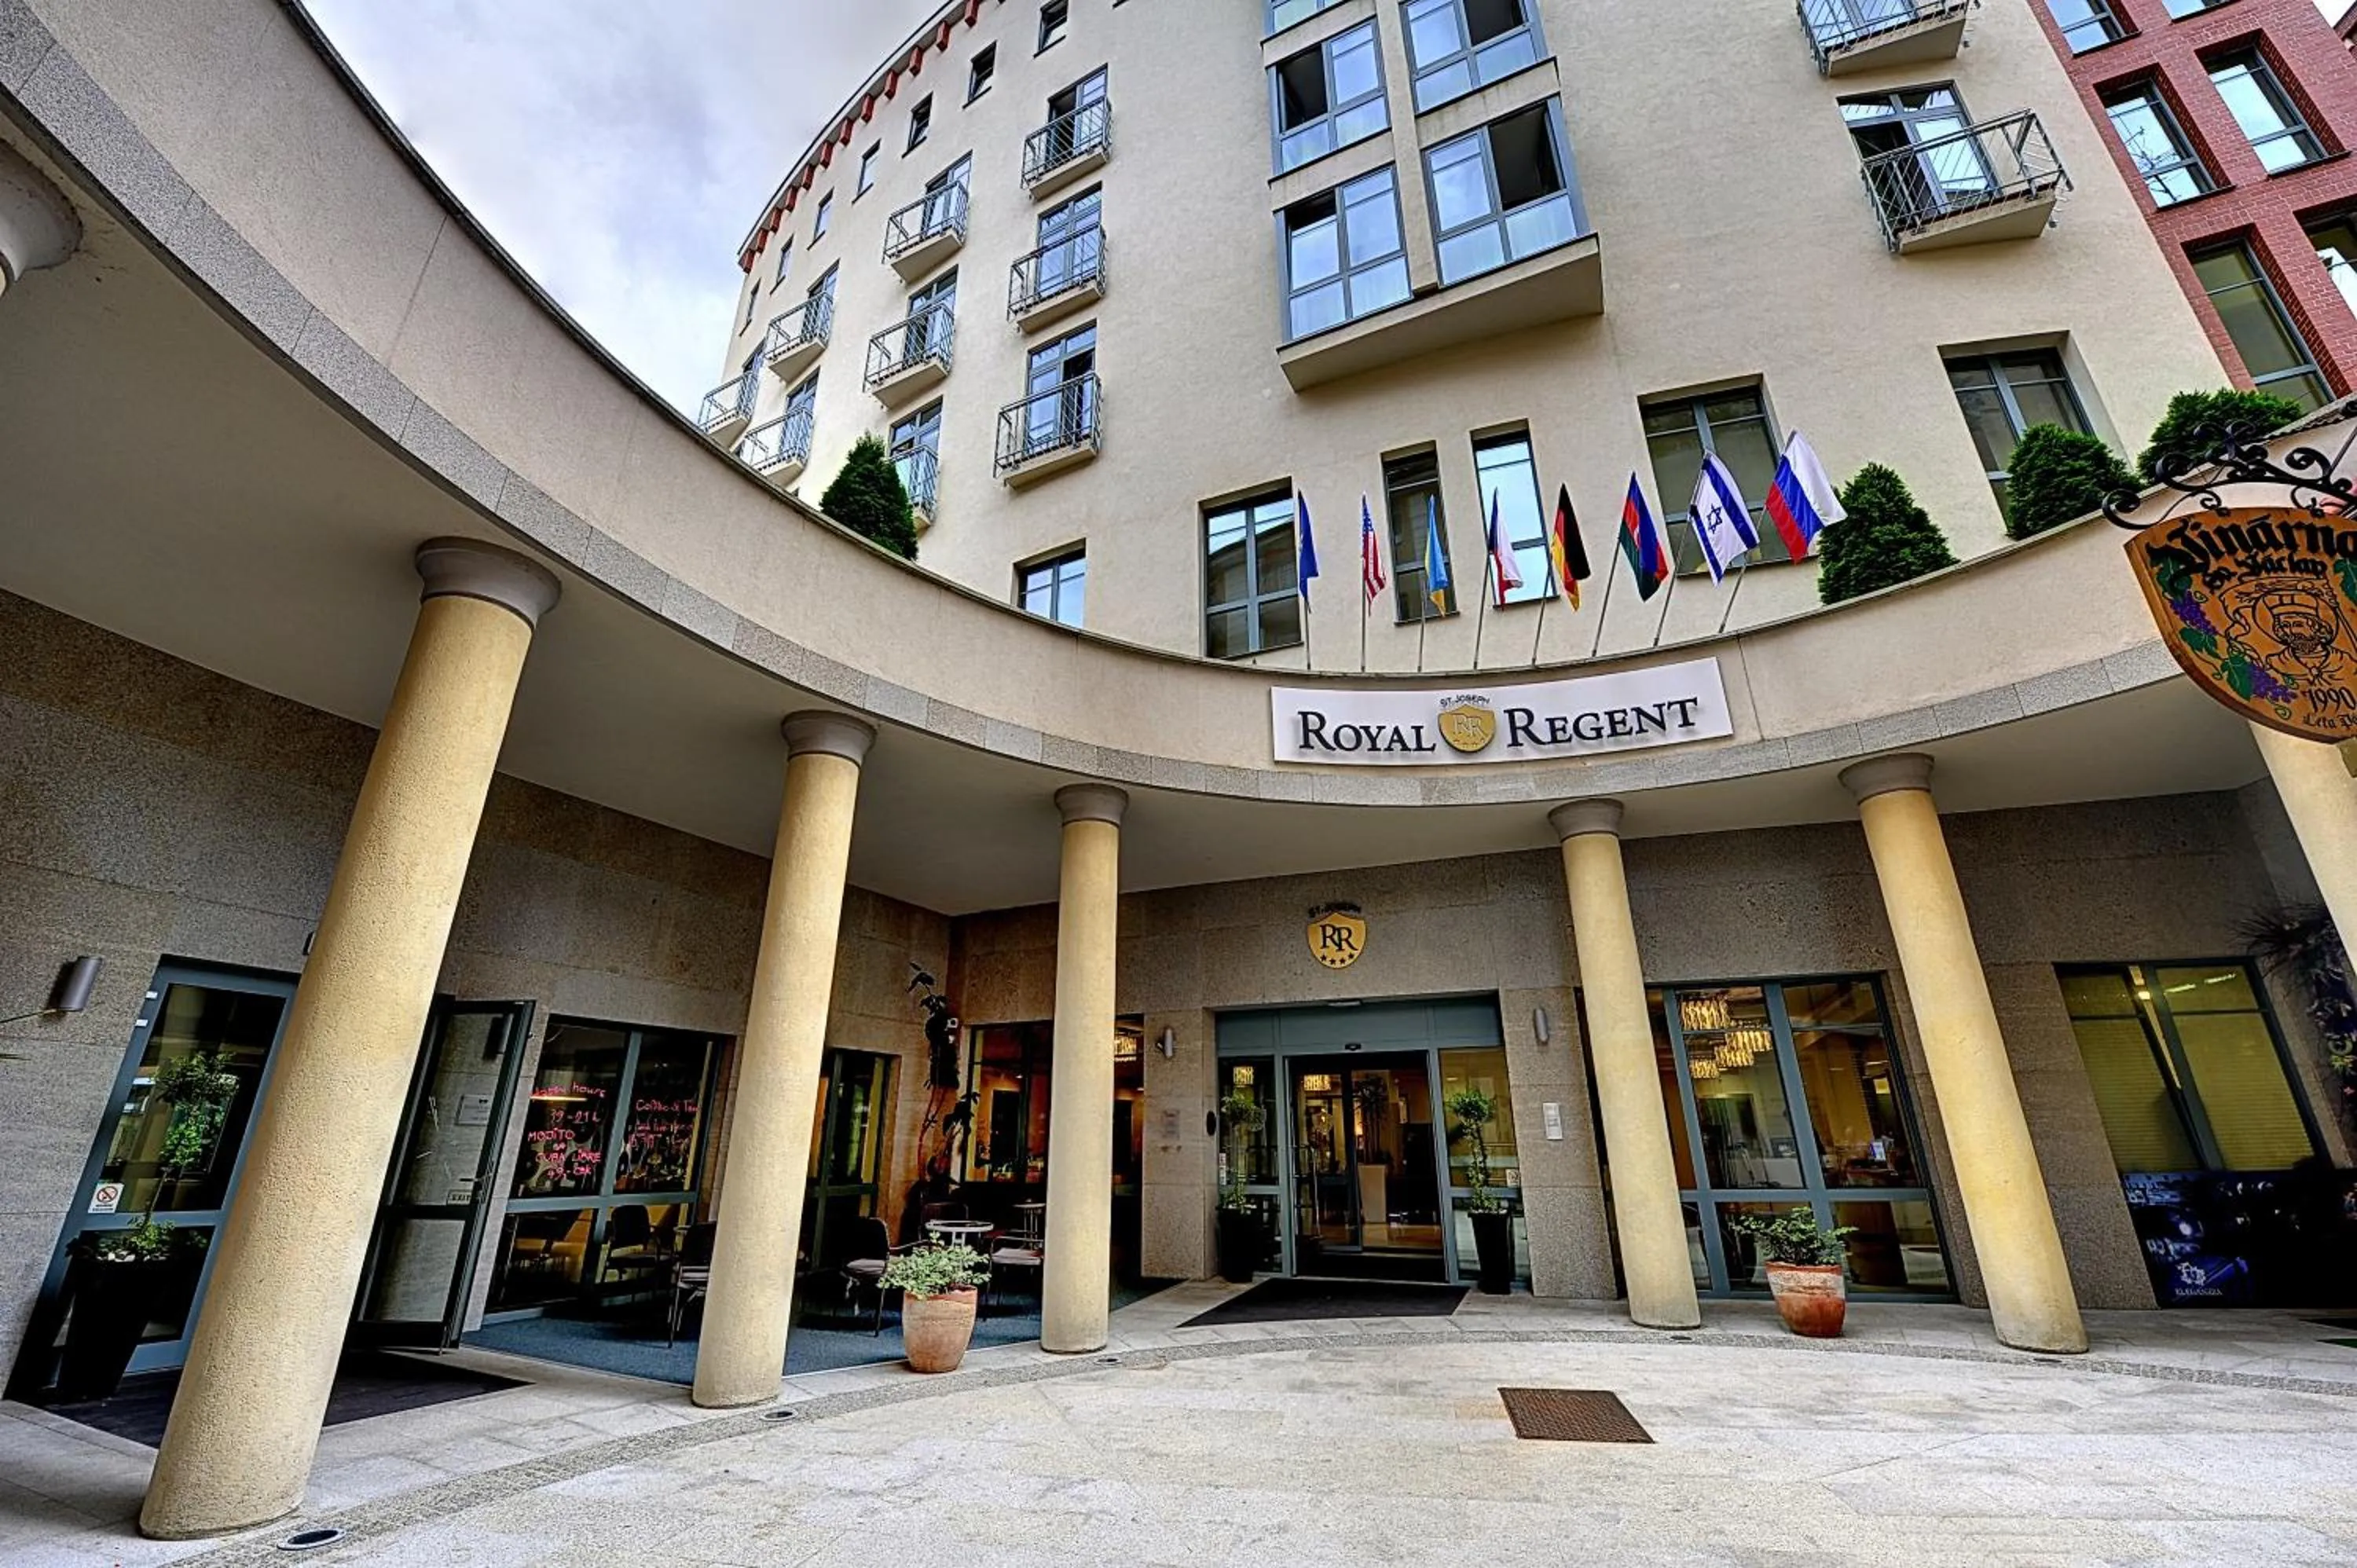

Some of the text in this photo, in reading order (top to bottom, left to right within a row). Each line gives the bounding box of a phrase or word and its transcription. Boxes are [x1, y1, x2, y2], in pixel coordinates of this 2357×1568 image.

[2300, 687, 2356, 713] 1990
[1298, 697, 1698, 752] ROYAL REGENT
[1453, 713, 1490, 739] RR
[1320, 924, 1358, 951] RR
